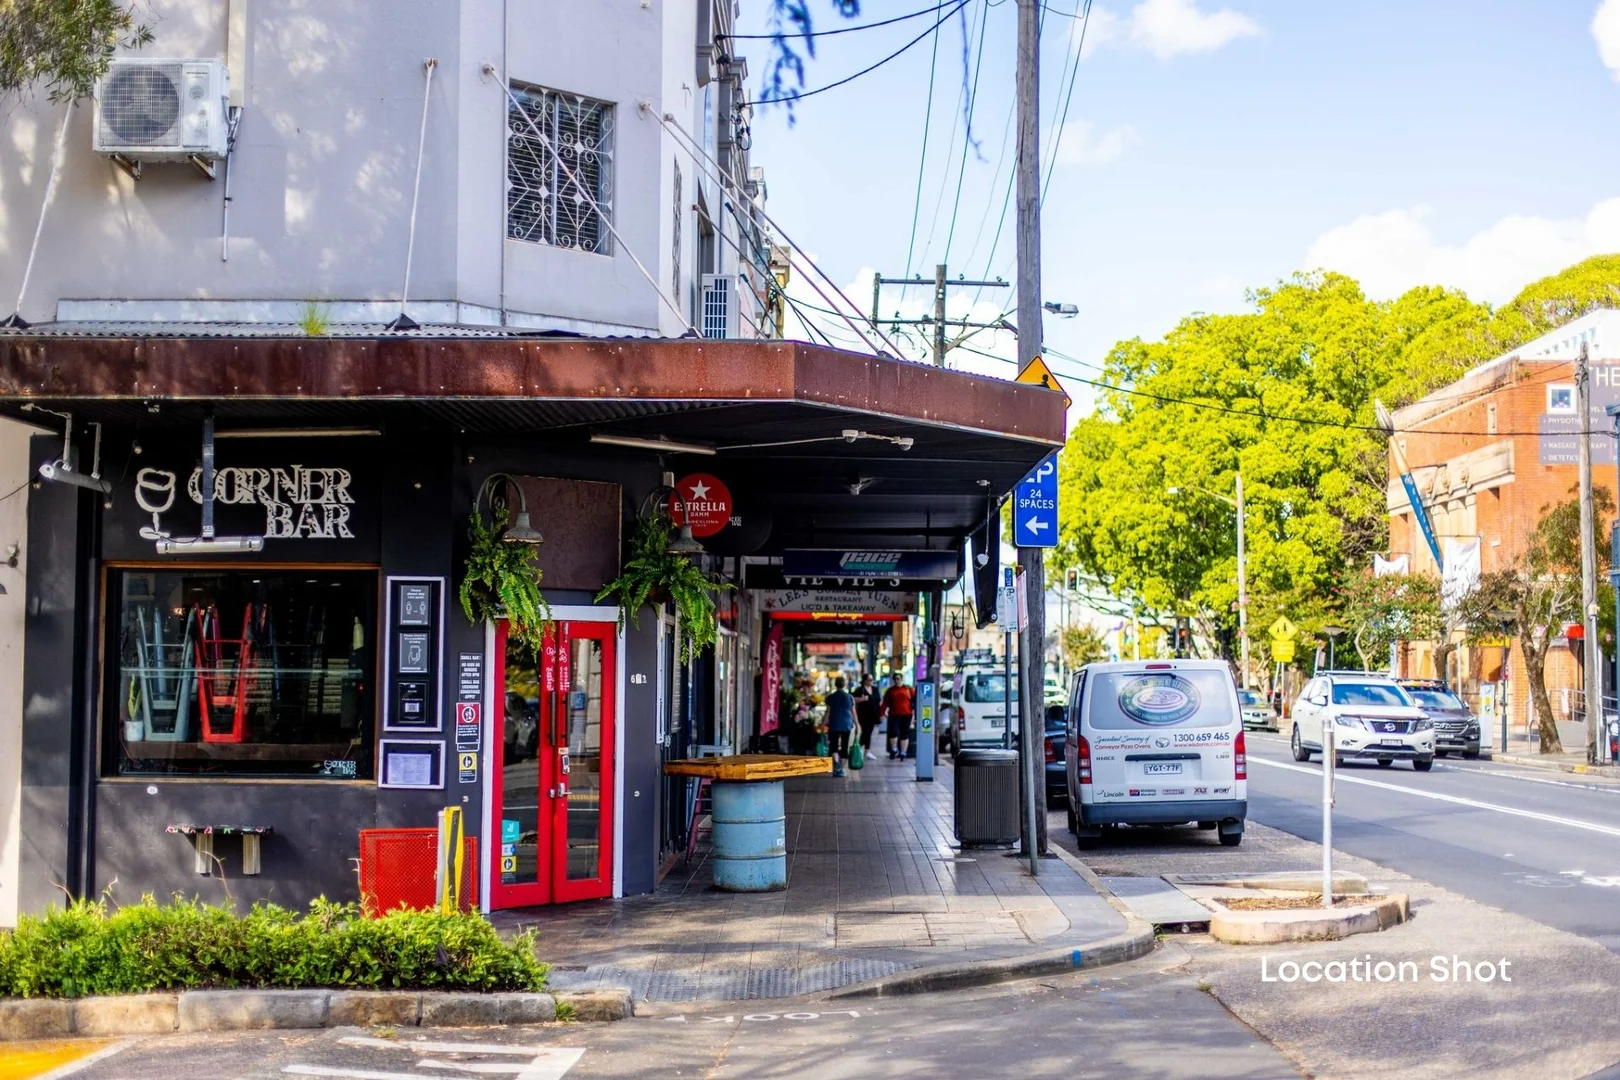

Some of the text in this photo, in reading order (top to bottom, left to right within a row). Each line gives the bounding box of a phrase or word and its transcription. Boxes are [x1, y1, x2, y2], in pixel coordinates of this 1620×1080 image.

[1589, 366, 1620, 387] HE
[187, 464, 355, 504] CORNER
[1030, 489, 1042, 498] 24
[1019, 498, 1054, 509] SPACES
[263, 502, 355, 539] BAR
[867, 590, 899, 611] YUEN
[833, 604, 876, 612] TAKEAWAY
[630, 673, 647, 684] 62
[924, 684, 931, 695] P
[1173, 732, 1230, 742] 1300 659 465
[700, 1010, 861, 1023] LOOK
